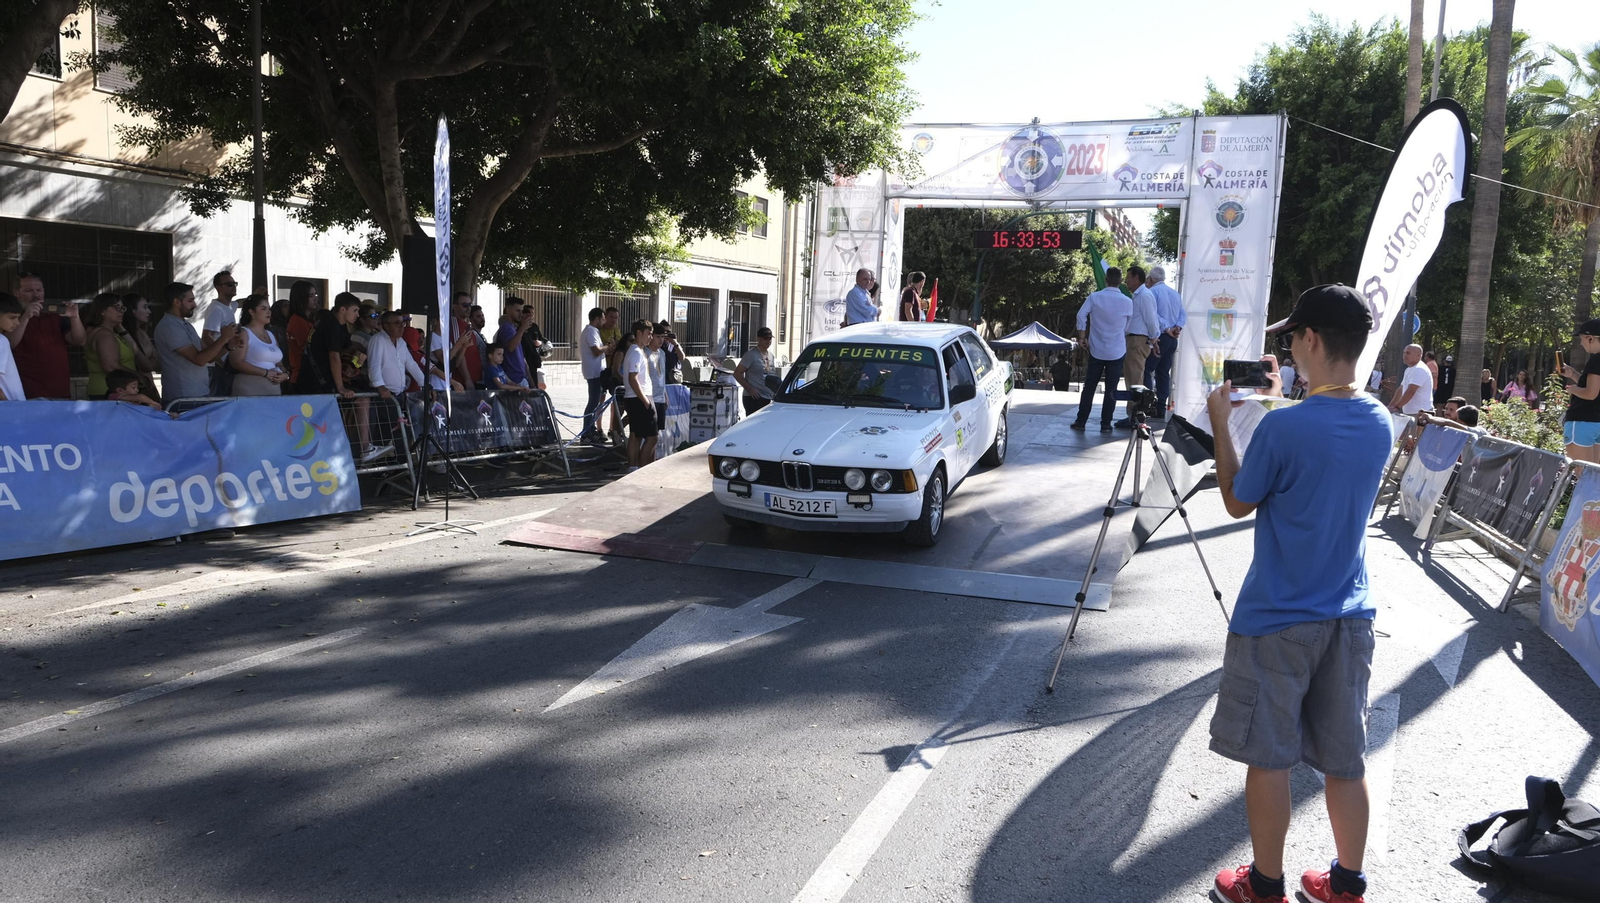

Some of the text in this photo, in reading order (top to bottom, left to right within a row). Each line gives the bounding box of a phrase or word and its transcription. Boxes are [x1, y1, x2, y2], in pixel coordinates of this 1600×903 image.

[1220, 135, 1273, 144] DIPUTACIÓN
[1233, 143, 1270, 152] ALMERÍA
[1066, 143, 1106, 176] 2023
[1140, 172, 1185, 180] COSTA DE
[1225, 169, 1268, 178] COSTA DE
[1131, 180, 1185, 192] ALMERÍA
[1215, 178, 1268, 189] ALMERÍA
[1383, 152, 1448, 274] dimoba
[992, 231, 1060, 248] 16:33:53
[813, 347, 923, 362] M. FUENTES
[109, 459, 340, 528] deportes
[772, 496, 832, 513] AL 5212 F
